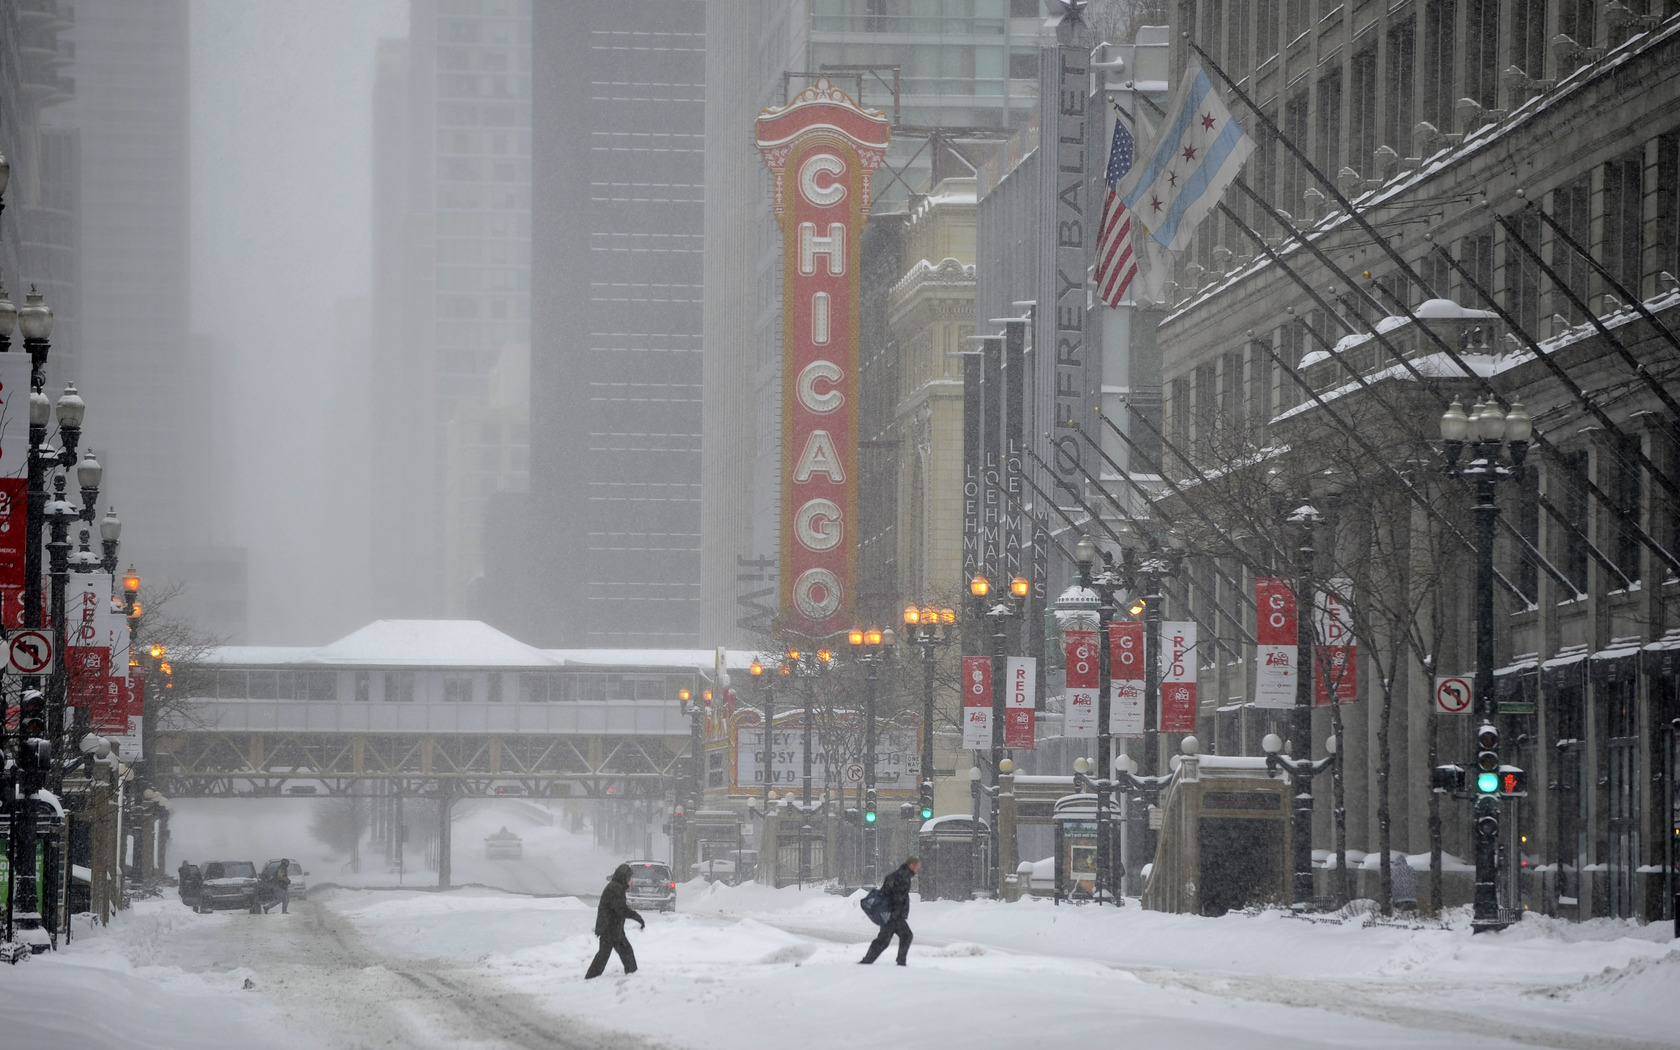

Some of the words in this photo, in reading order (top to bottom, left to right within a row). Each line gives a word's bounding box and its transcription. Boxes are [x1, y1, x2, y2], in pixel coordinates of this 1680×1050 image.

[1058, 54, 1086, 249] BALLET
[792, 153, 847, 622] CHICAGO
[1055, 268, 1083, 505] JOFFREY
[82, 592, 96, 640] RED
[1269, 594, 1285, 628] GO
[1076, 646, 1089, 674] GO
[1120, 636, 1134, 665] GO
[1173, 636, 1185, 677] RED
[1274, 655, 1289, 666] Red
[972, 670, 984, 695] GO
[1015, 669, 1026, 703] RED
